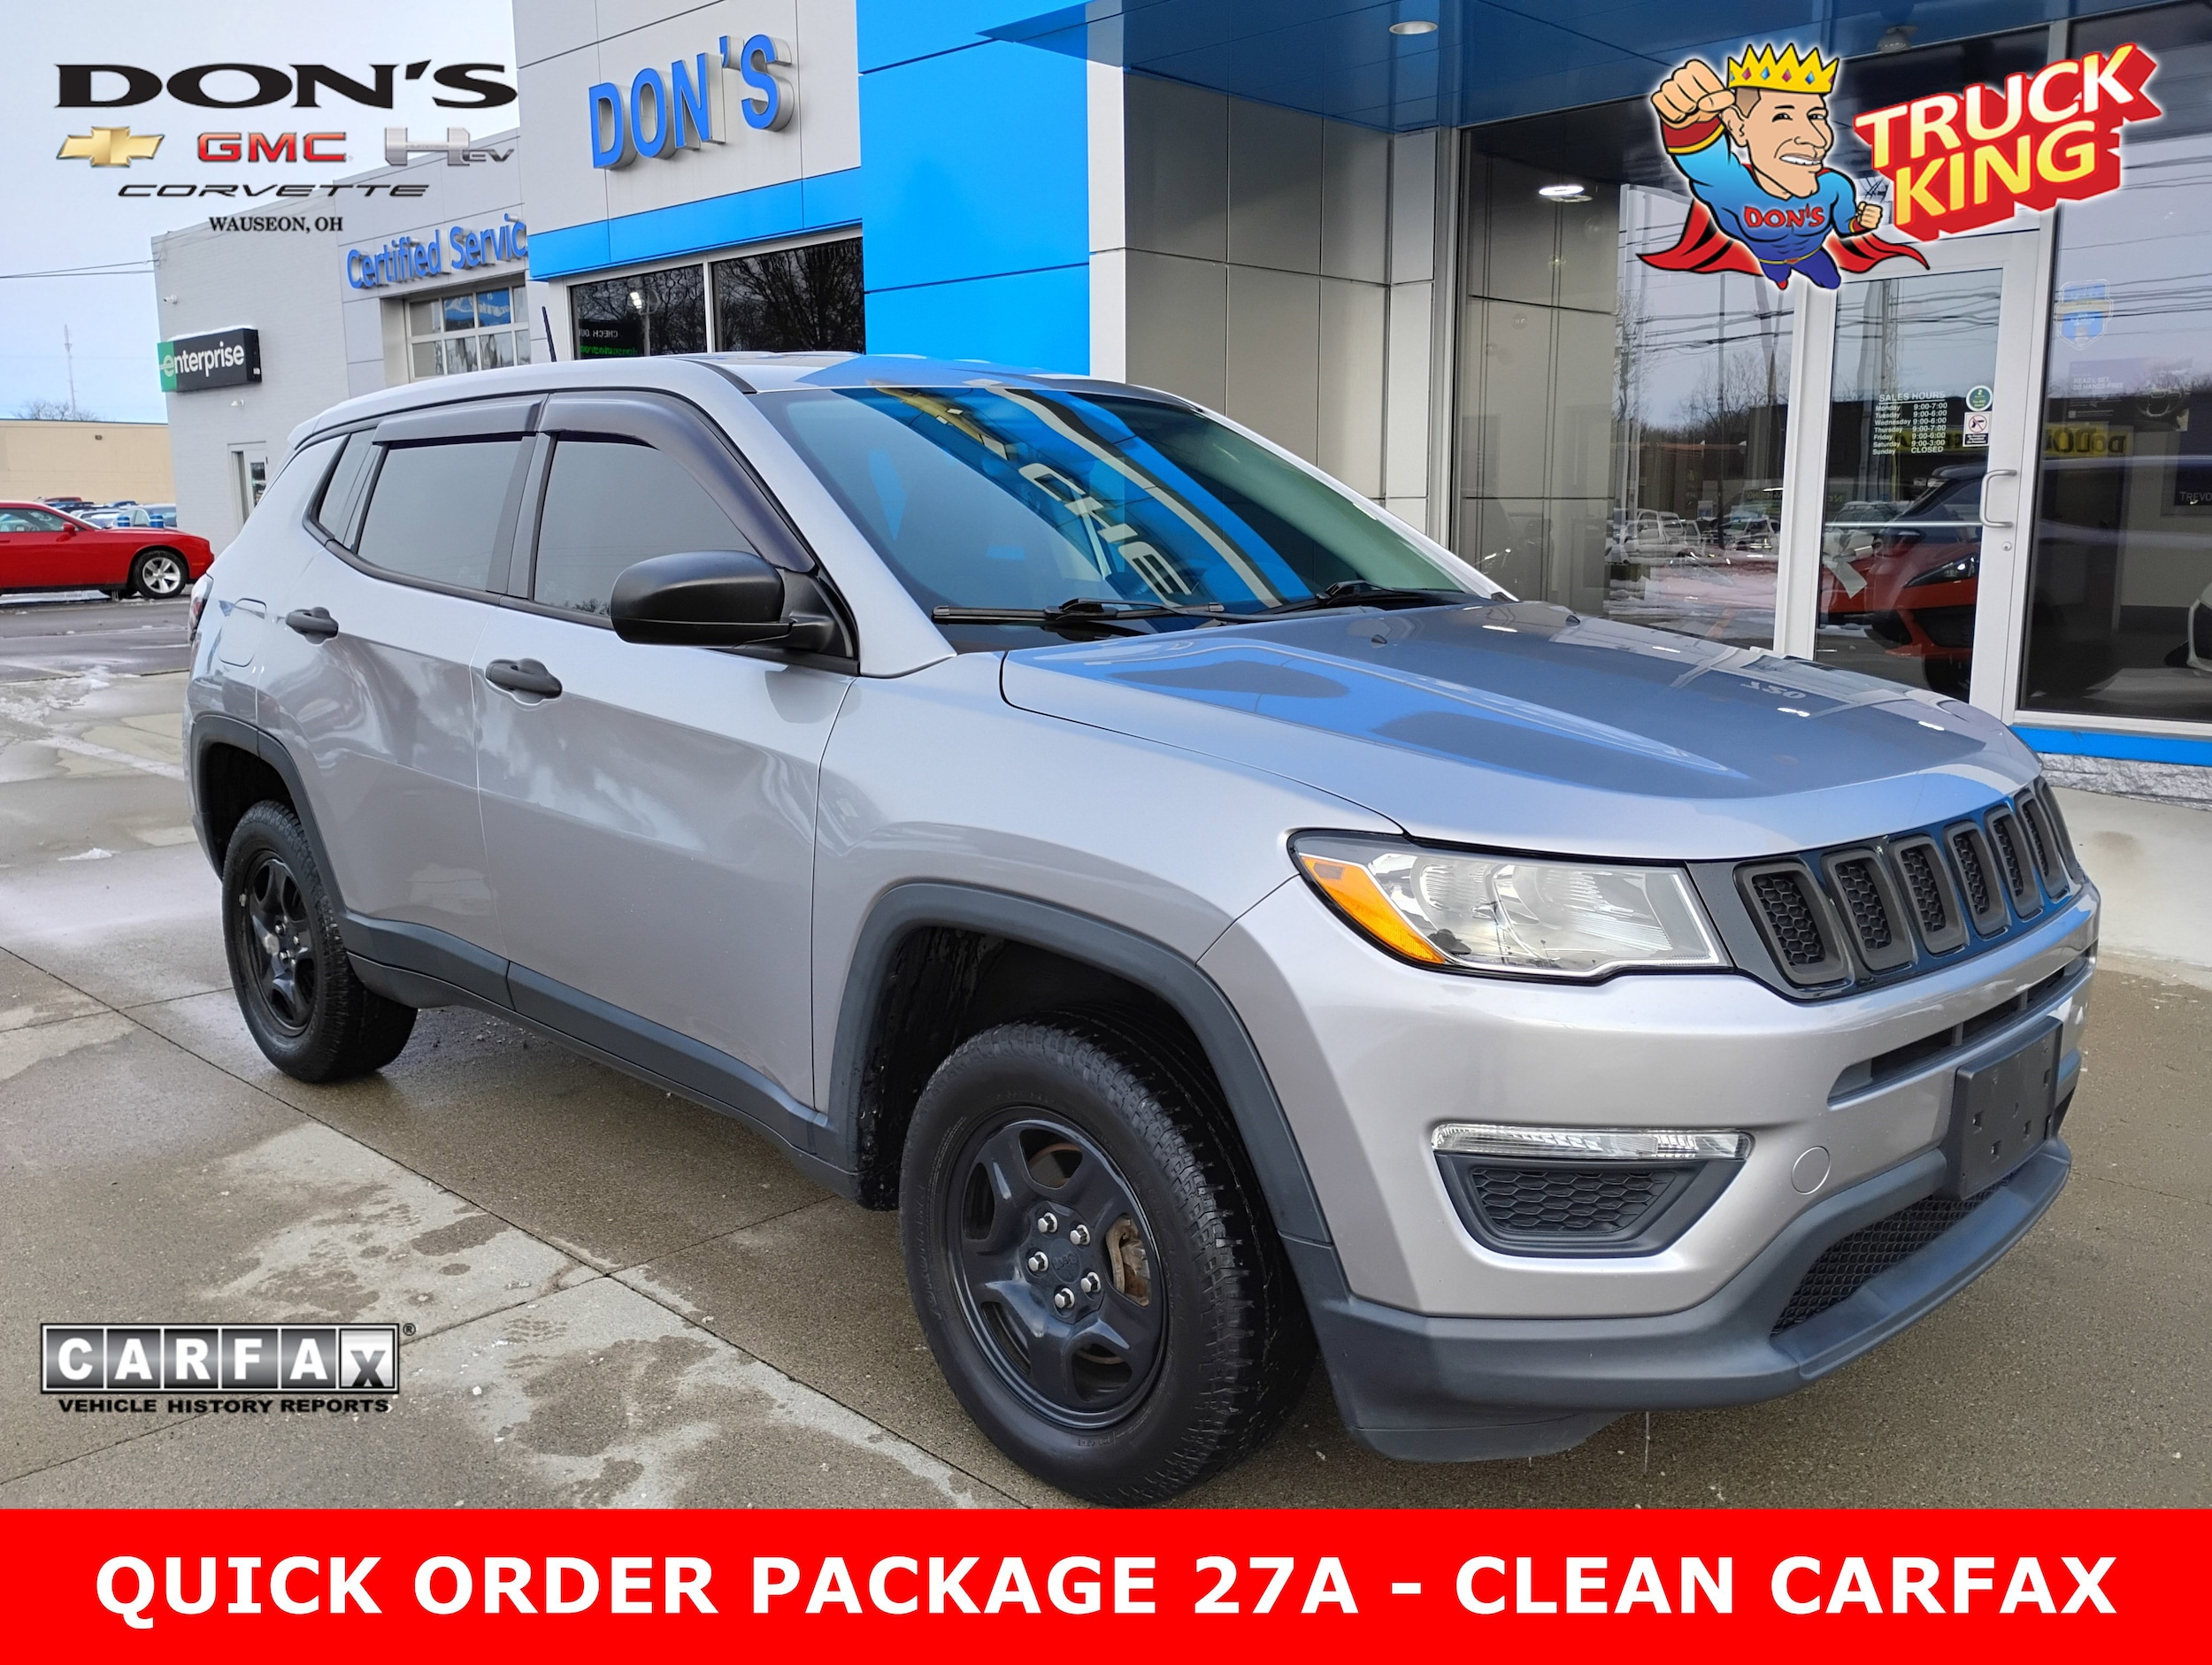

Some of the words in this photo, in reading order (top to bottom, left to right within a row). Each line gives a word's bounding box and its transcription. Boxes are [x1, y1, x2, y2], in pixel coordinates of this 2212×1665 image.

[589, 35, 787, 169] DON'S
[346, 229, 442, 289] Certified
[449, 212, 528, 270] Servic
[161, 341, 245, 378] enterprise
[1878, 393, 1909, 402] SALES
[1911, 390, 1946, 400] HOURS
[1913, 402, 1947, 410] 9:00-7:00
